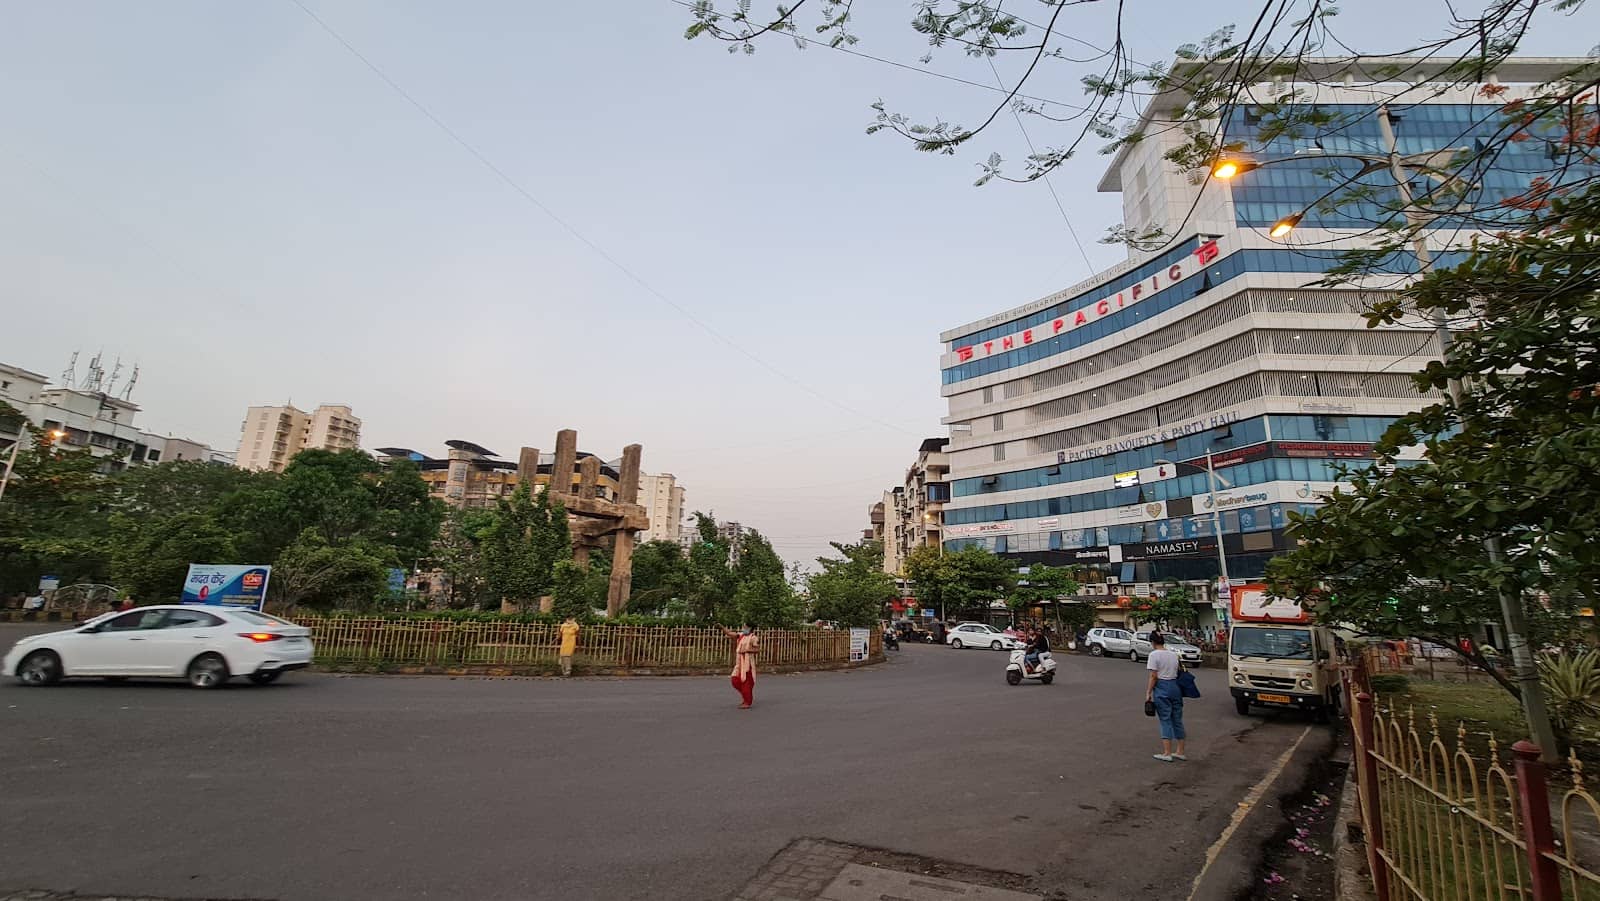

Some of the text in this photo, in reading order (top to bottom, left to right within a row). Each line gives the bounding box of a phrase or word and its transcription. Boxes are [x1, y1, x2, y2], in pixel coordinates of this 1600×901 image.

[984, 329, 1033, 355] THE
[1053, 263, 1182, 334] PACIFIC
[1069, 446, 1102, 462] PACIFIC
[1106, 433, 1157, 457] BANQUETS
[1160, 431, 1169, 441] &
[1172, 420, 1206, 439] PARTY
[1210, 411, 1240, 428] HALL
